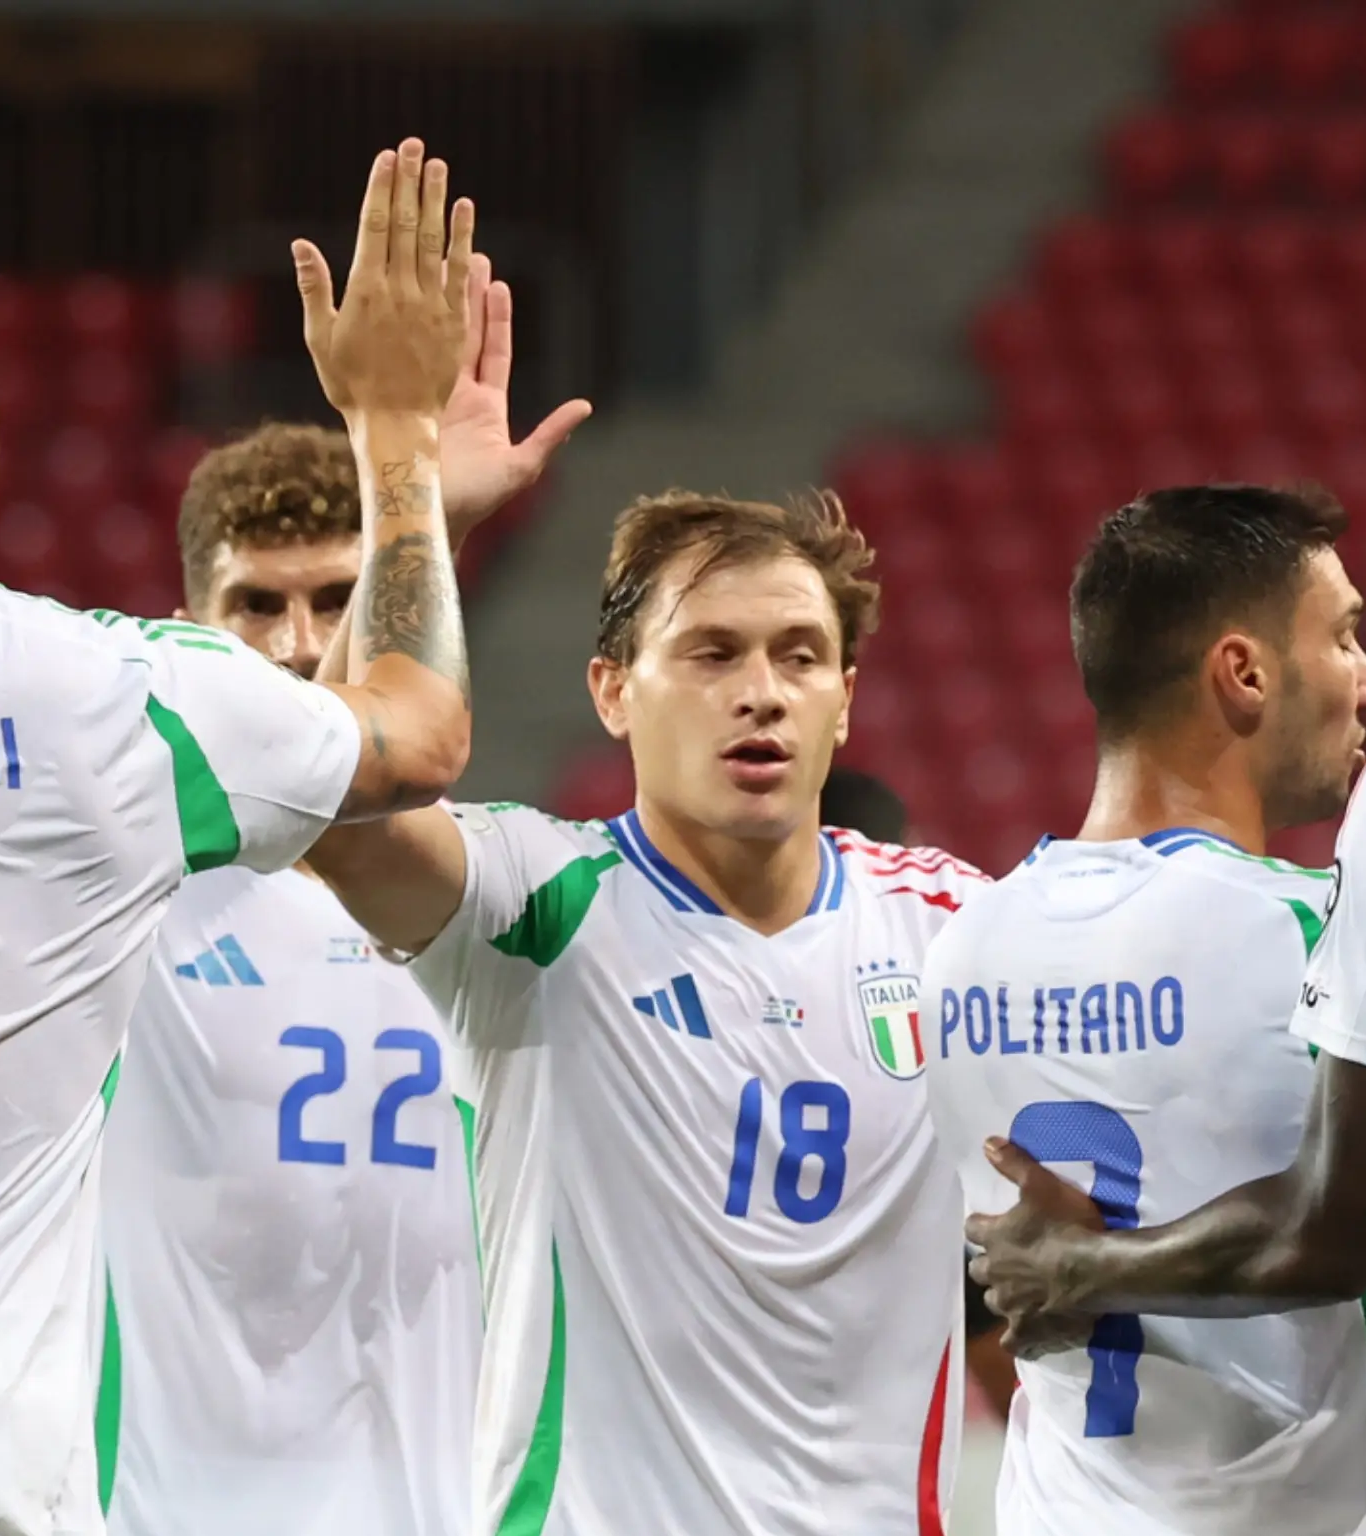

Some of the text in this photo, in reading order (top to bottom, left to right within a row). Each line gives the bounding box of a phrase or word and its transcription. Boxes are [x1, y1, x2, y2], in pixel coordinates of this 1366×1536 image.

[863, 983, 918, 1006] ITALIA
[940, 975, 1185, 1060] POLITANO
[278, 1025, 443, 1172] 22
[723, 1077, 852, 1225] 18
